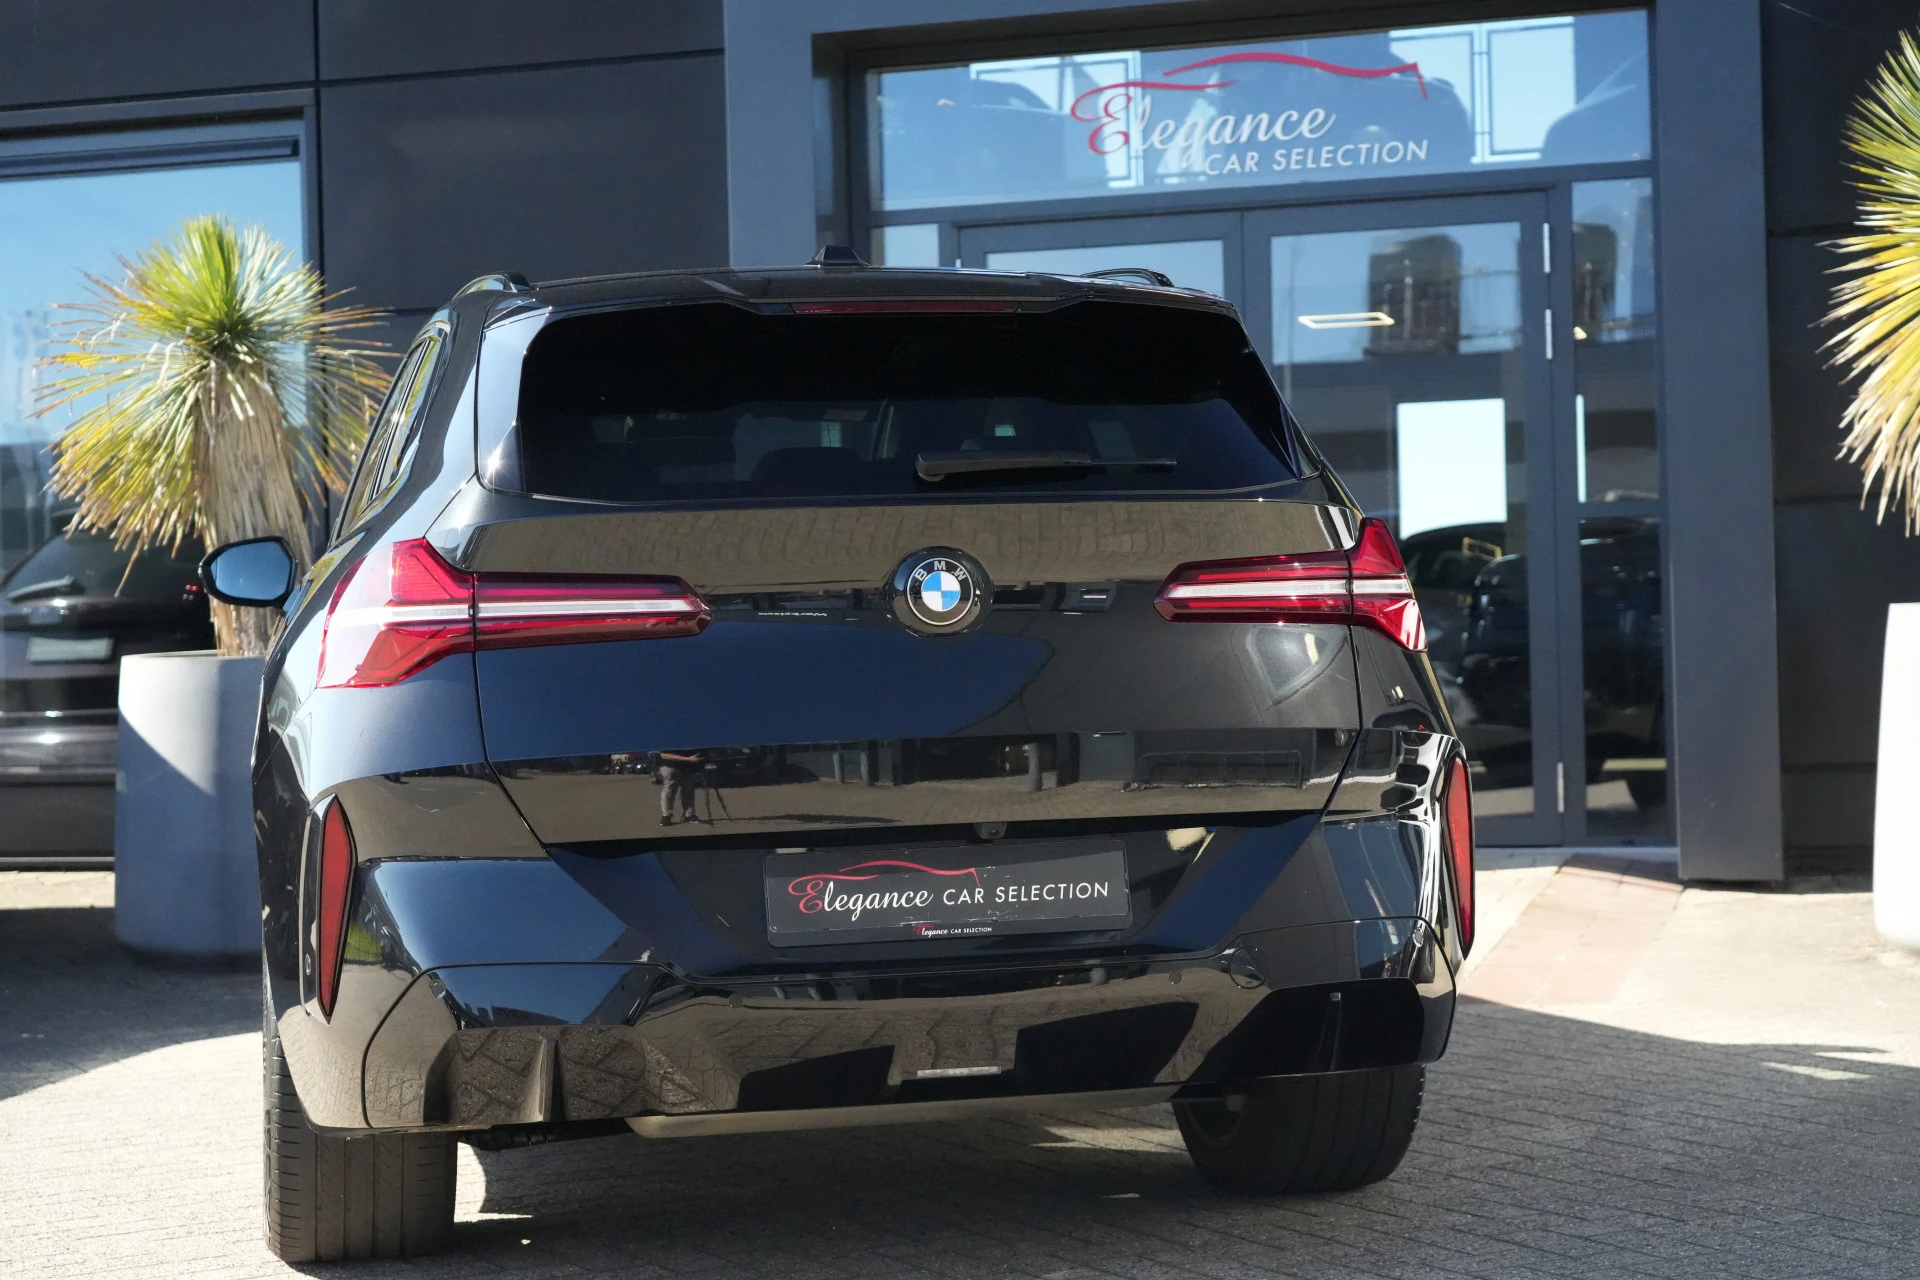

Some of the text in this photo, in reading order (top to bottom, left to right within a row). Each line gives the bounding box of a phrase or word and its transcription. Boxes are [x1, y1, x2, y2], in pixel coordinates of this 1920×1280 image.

[1071, 88, 1336, 168] Elegance
[1205, 139, 1429, 176] CAR SELECTION
[914, 560, 967, 581] BMW
[788, 878, 1109, 921] Elegance CAR SELECTION
[913, 925, 949, 938] Elegance
